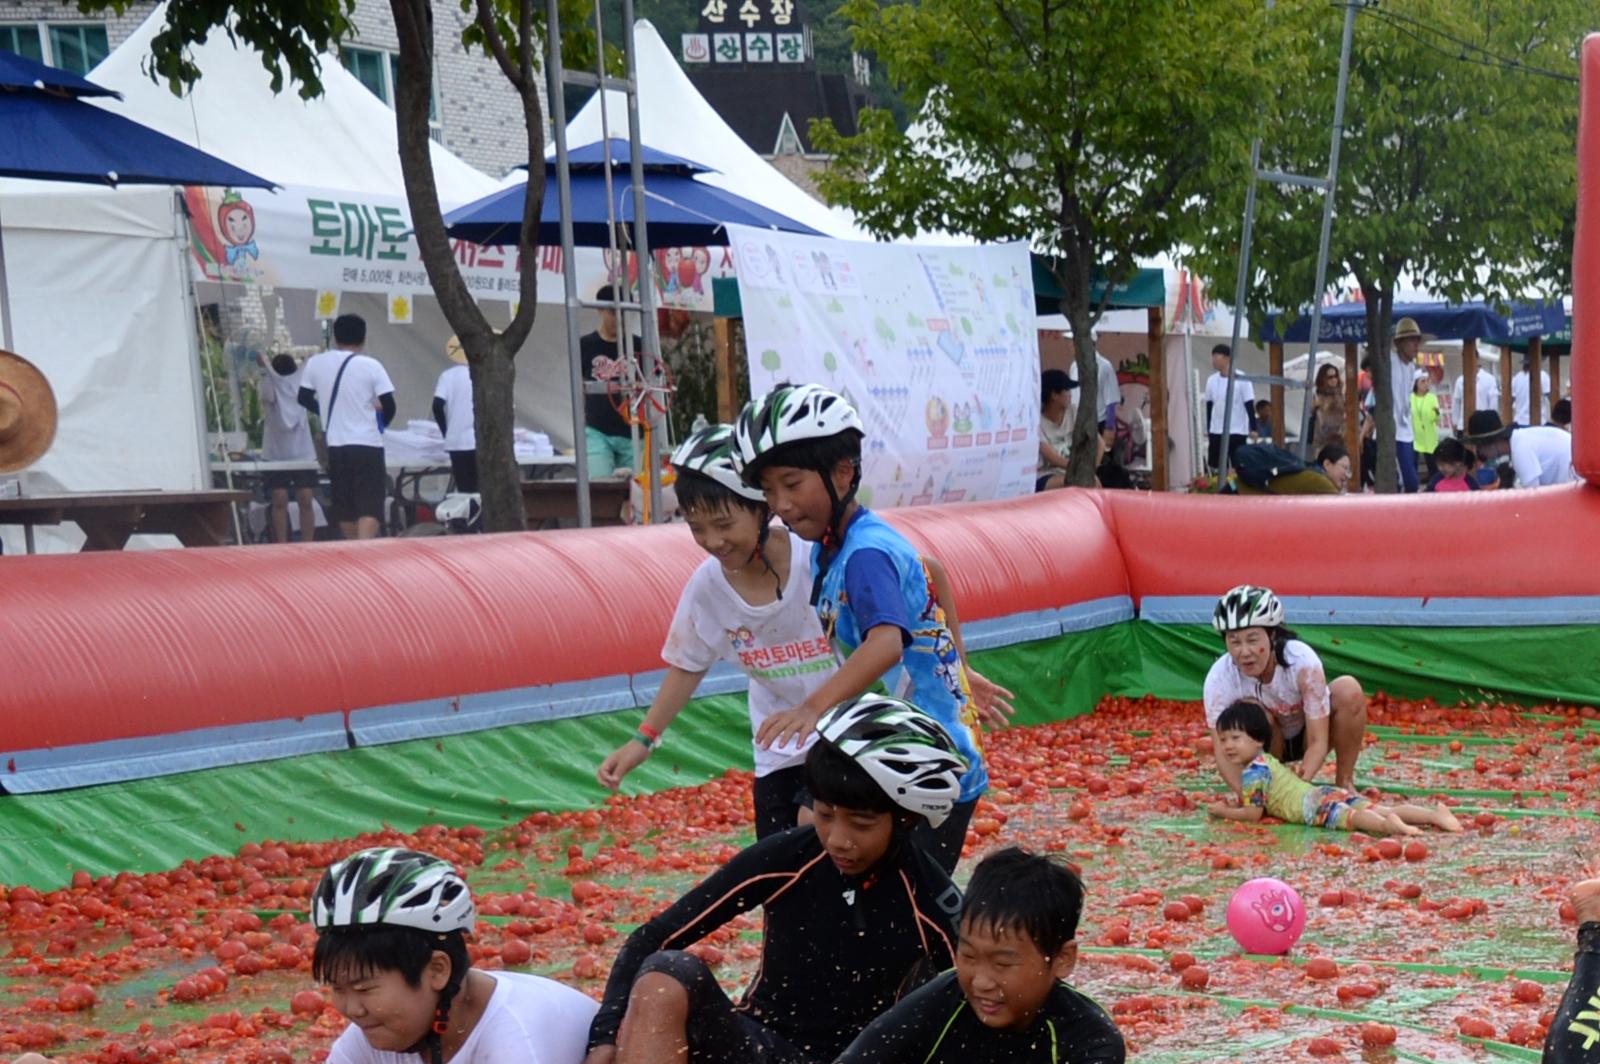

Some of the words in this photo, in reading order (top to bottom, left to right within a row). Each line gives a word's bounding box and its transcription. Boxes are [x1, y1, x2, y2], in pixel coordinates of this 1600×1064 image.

[701, 0, 795, 28] 산수장
[717, 34, 801, 60] 산수장
[306, 198, 410, 262] 토마토
